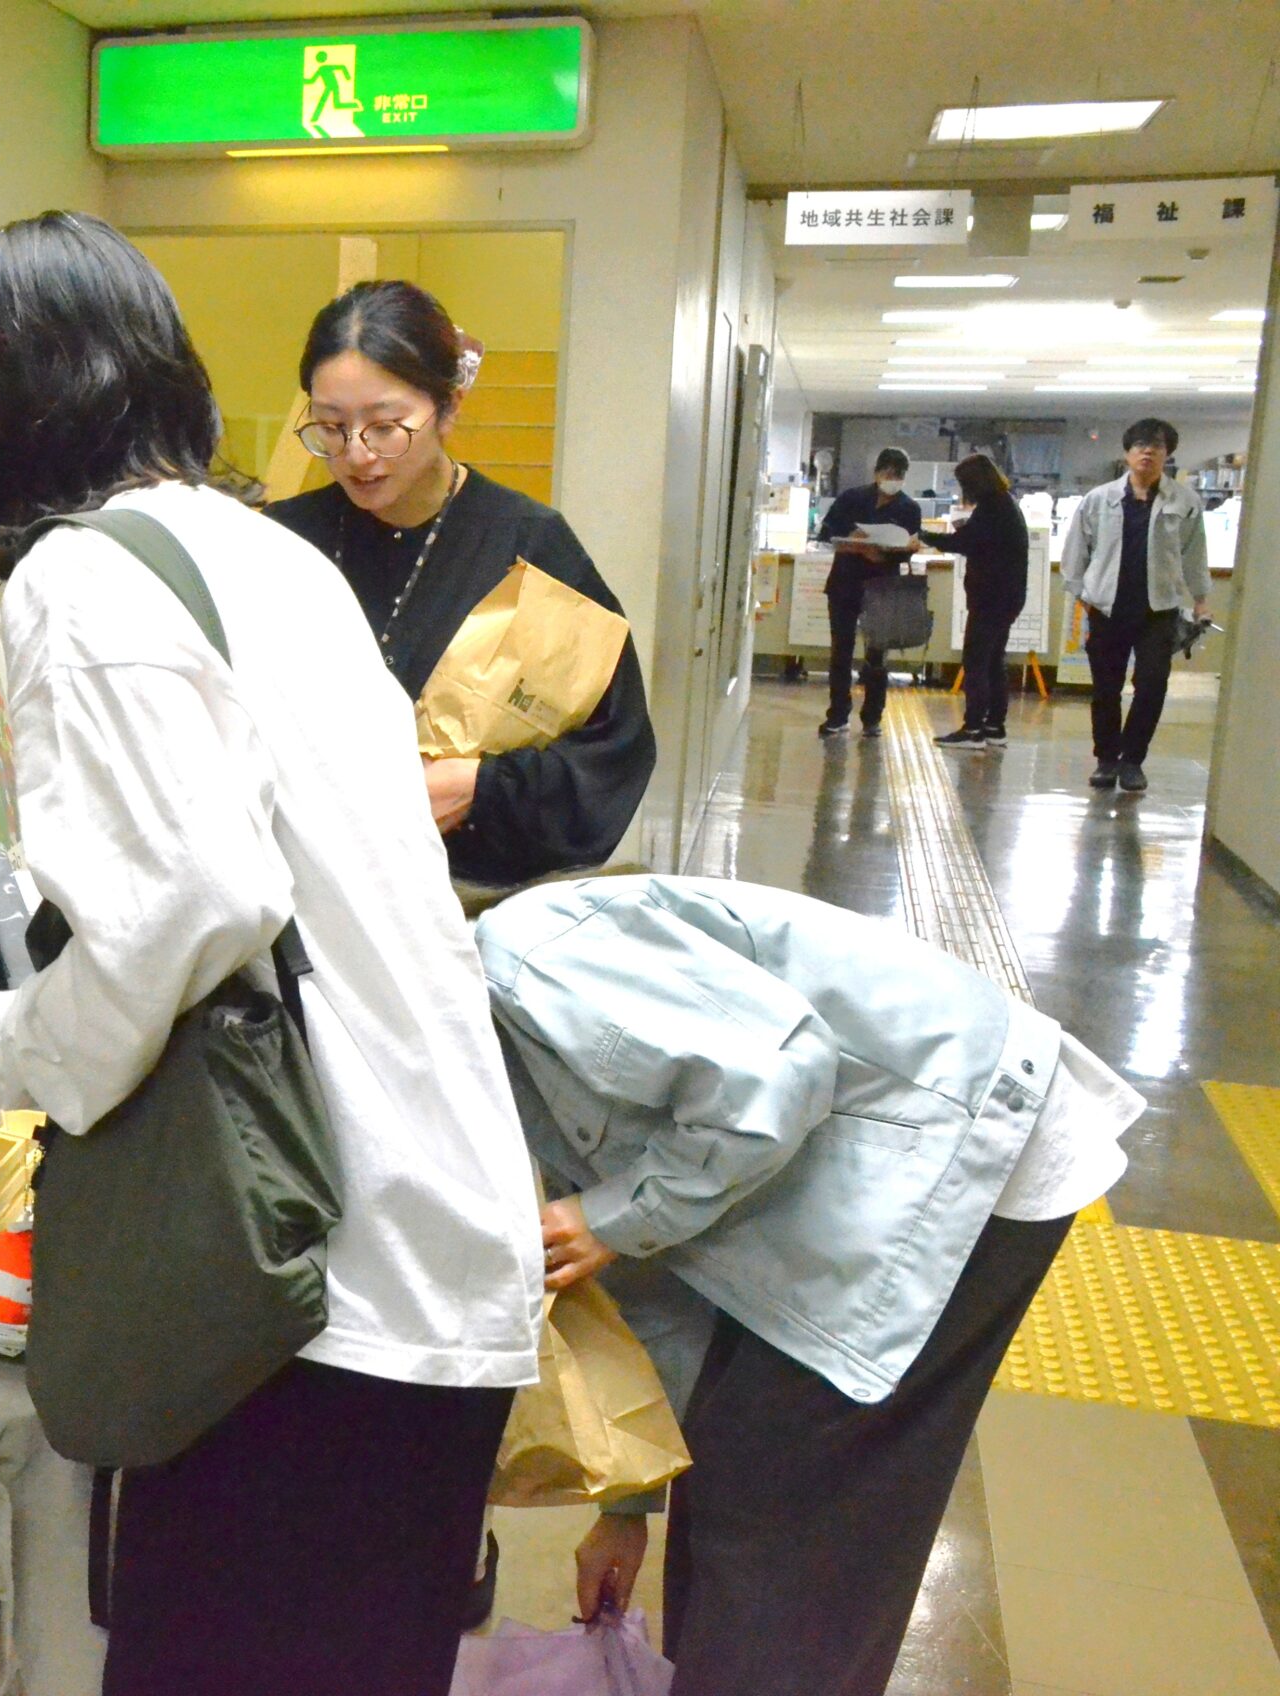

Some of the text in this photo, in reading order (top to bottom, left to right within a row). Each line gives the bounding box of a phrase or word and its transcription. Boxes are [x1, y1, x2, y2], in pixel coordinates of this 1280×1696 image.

[374, 94, 427, 111] 非常口
[382, 112, 417, 123] EXIT
[800, 208, 954, 228] 地域共生社会課
